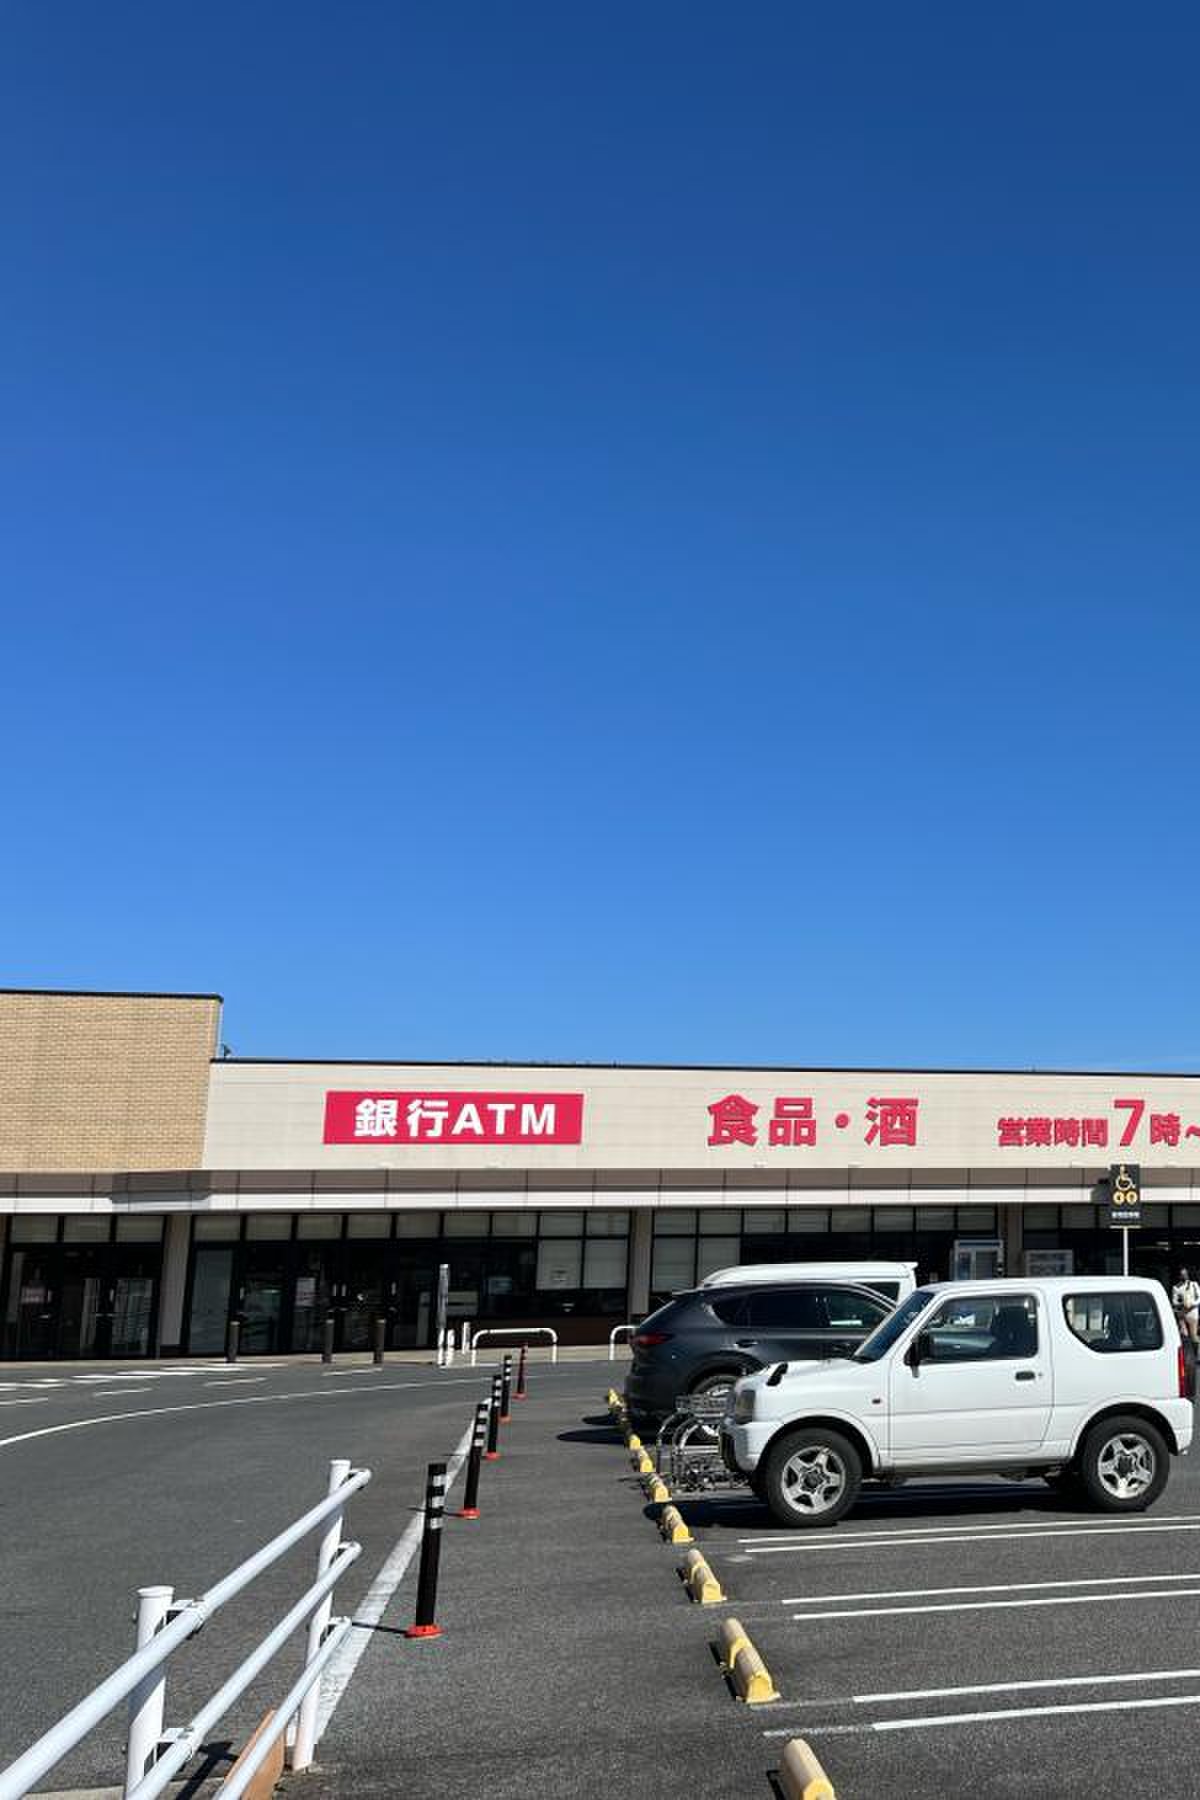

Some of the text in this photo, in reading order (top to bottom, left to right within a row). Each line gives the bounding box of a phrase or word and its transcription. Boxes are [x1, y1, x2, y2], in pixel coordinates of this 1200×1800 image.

[353, 1098, 557, 1138] 銀行ATM
[707, 1094, 919, 1147] 食品・酒
